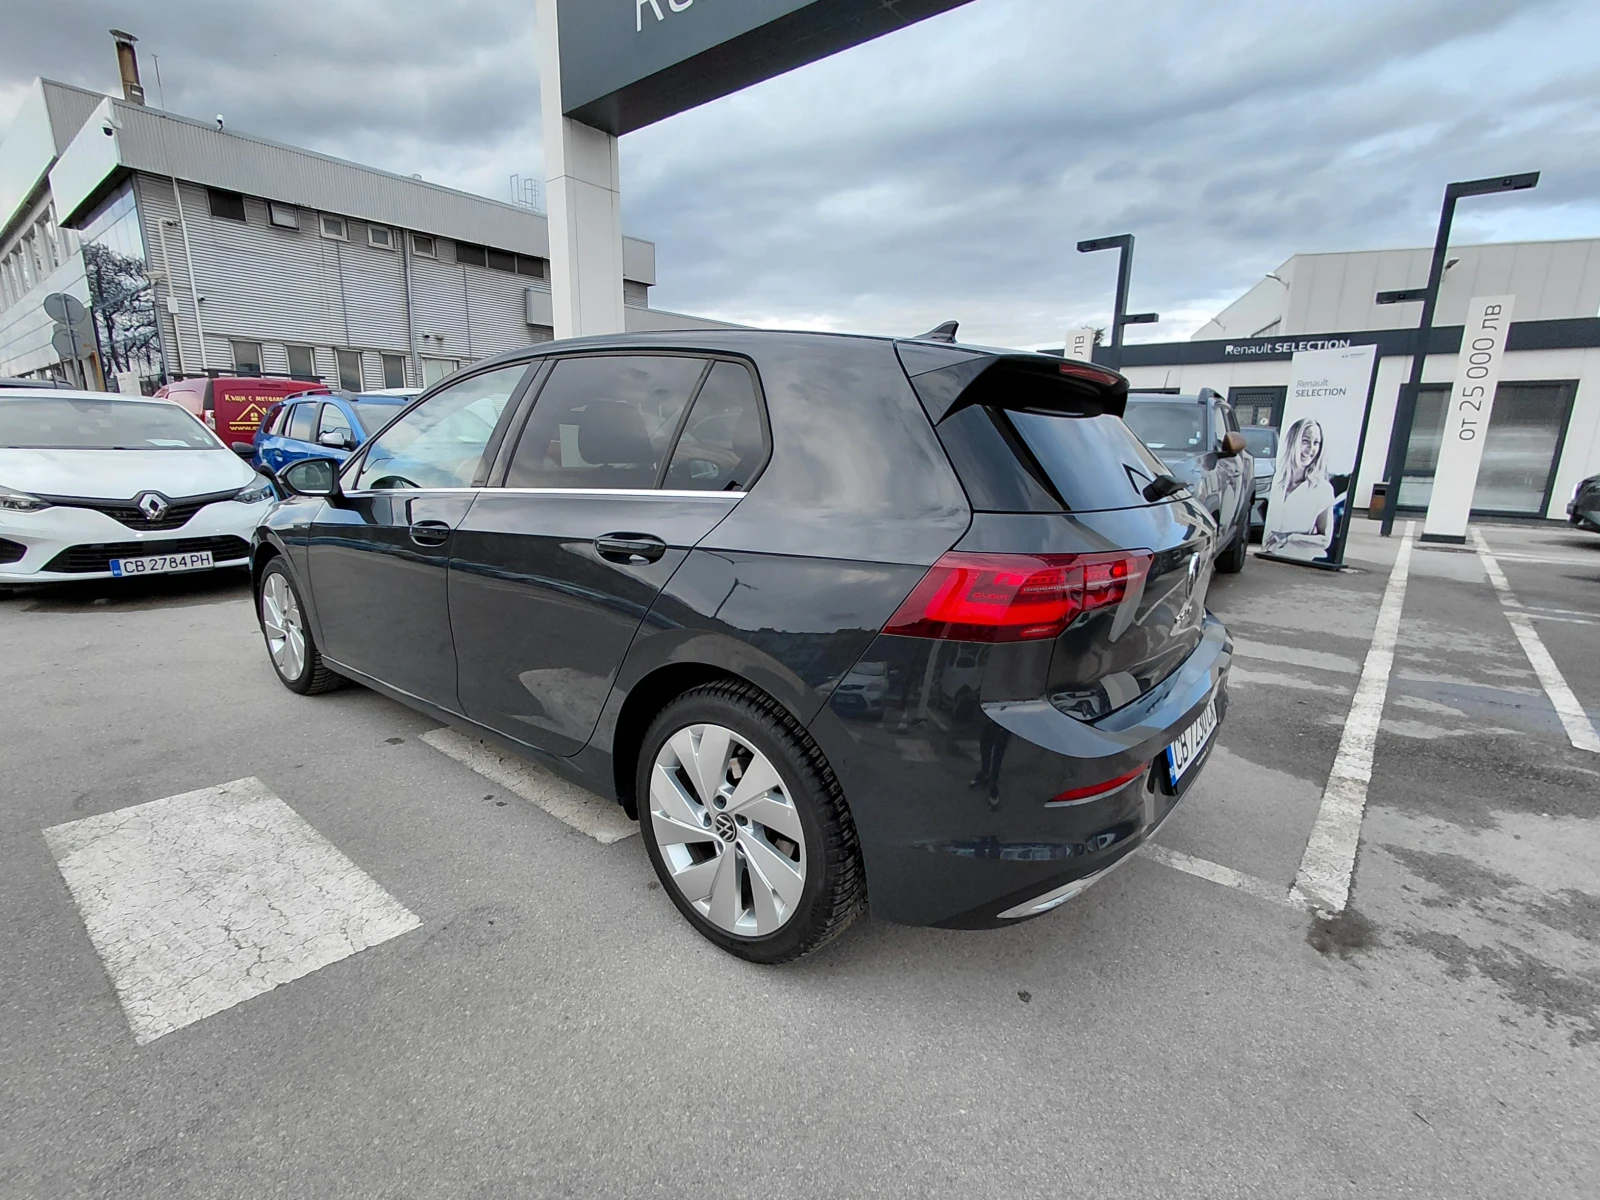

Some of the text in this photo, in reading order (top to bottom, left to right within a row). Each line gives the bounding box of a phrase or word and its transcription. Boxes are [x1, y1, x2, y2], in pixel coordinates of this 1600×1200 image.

[1225, 339, 1351, 355] Renault SELECTION
[1466, 338, 1495, 379] 000
[1296, 379, 1329, 388] Renault
[224, 394, 247, 402] Къщи
[1295, 388, 1347, 397] SELECTION
[1460, 386, 1485, 411] 25
[123, 553, 211, 573] CB 2784 PH
